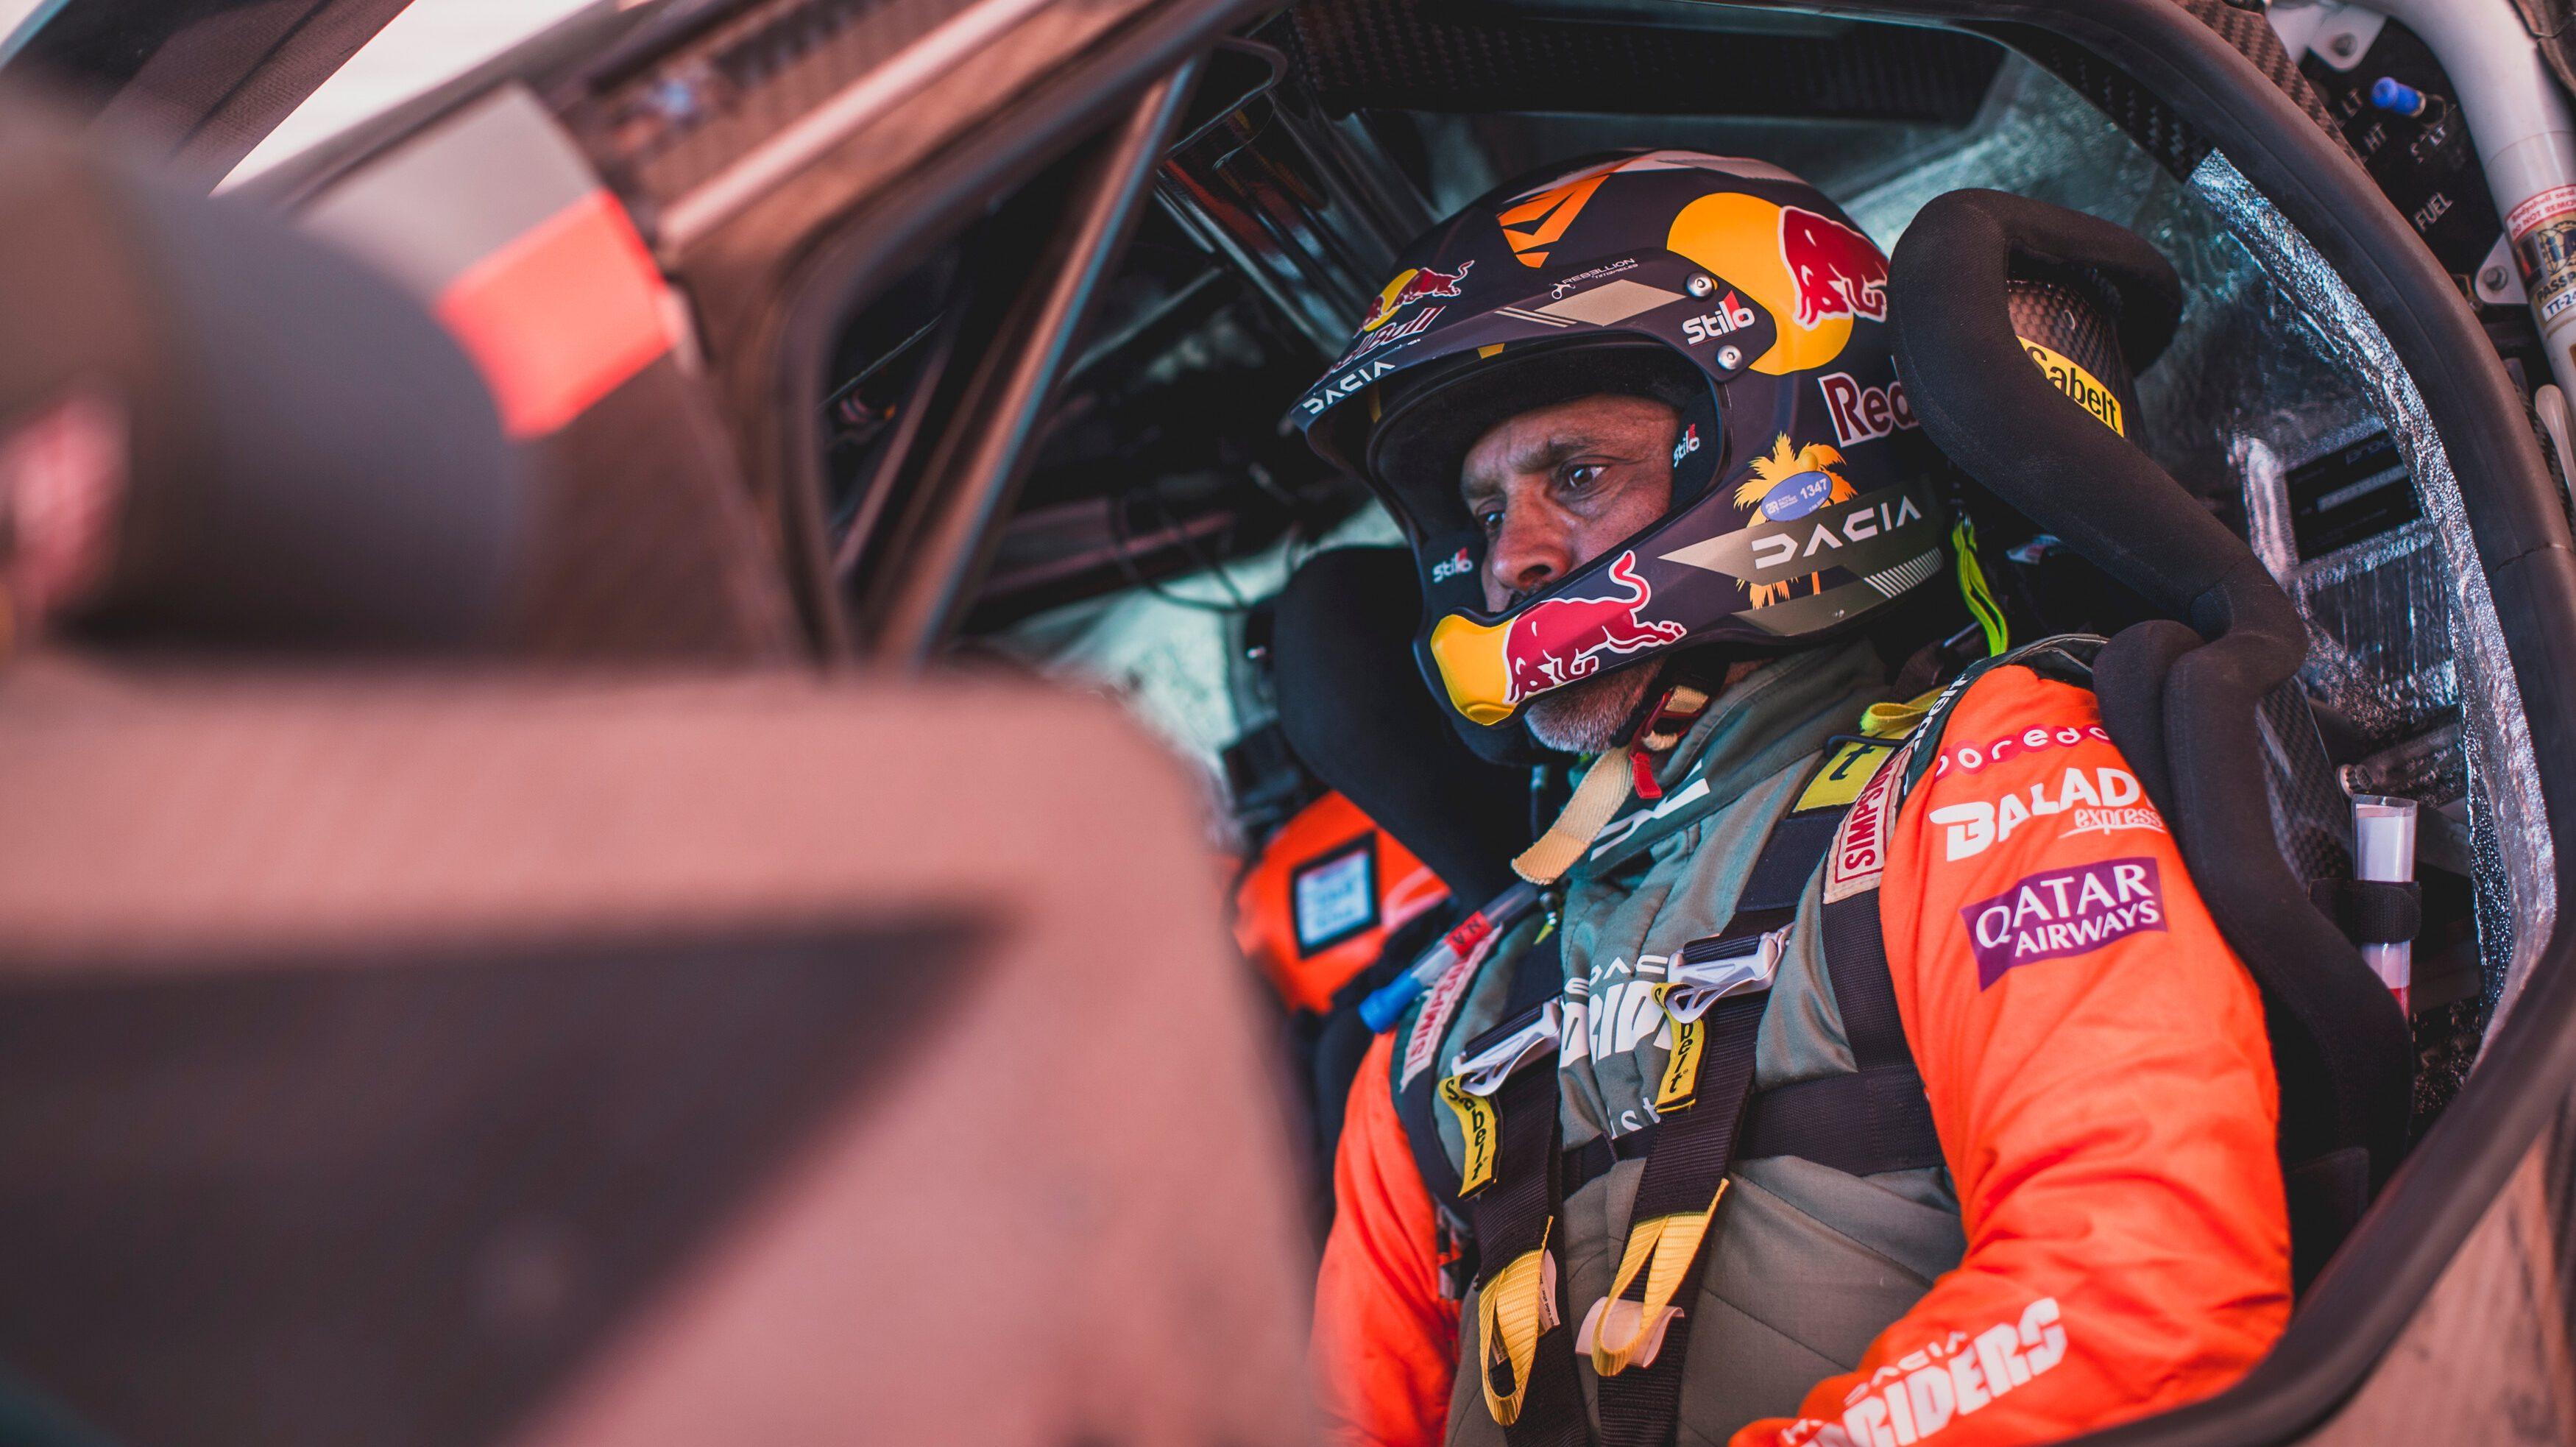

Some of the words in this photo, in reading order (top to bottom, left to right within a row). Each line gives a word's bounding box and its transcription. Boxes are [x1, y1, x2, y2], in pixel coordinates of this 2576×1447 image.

[2414, 191, 2453, 233] FUEL
[2544, 197, 2576, 213] REMO
[1562, 258, 1635, 285] REBELLION
[1302, 361, 1395, 414] DACIA
[1800, 478, 1827, 499] 1347
[1751, 495, 1922, 570] DACIA
[1929, 767, 2156, 862] BALAD
[2074, 807, 2163, 835] express
[1976, 864, 2154, 948] QATAR
[2014, 900, 2159, 958] AIRWAYS
[1446, 1079, 1487, 1181] Sabelt
[1844, 1331, 1968, 1407] DACIA
